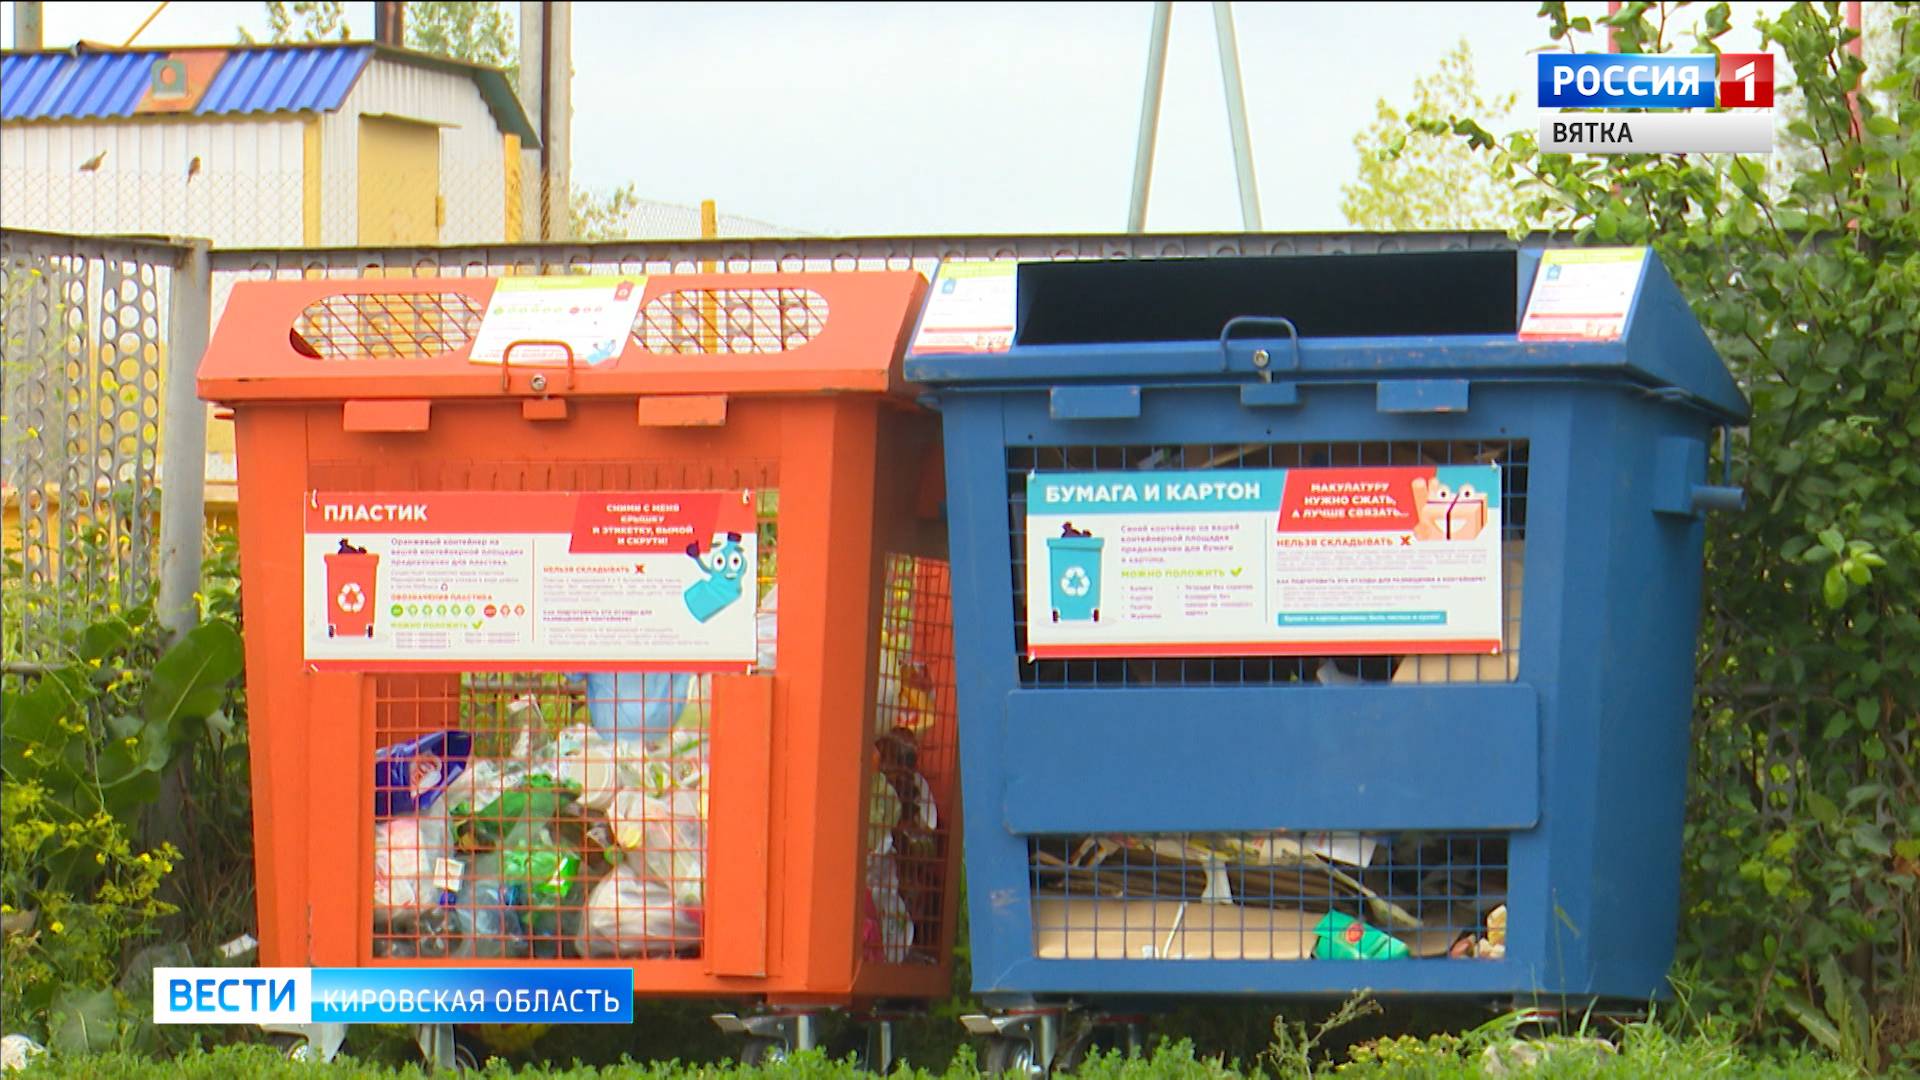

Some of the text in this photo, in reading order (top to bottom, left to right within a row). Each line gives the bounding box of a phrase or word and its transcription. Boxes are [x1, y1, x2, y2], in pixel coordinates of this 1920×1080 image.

[1046, 482, 1260, 502] БУМАГА И КАРТОН
[1311, 483, 1390, 493] МАКУЛАТУРУ
[1304, 495, 1397, 506] НУЖНО СЖАТЬ,
[324, 504, 429, 521] ПЛАСТИК
[607, 504, 680, 512] СНИМИ С МЕНЯ
[1292, 508, 1409, 518] А ЛУЧШЕ СВЯЗАТЬ...
[620, 515, 665, 523] КРЫШКУ
[592, 525, 694, 536] И ЭТИКЕТКУ, ВЫМОЙ
[1150, 524, 1196, 532] контейнер
[391, 538, 442, 547] Оранжевый
[443, 539, 488, 547] контейнер
[617, 537, 668, 545] И СКРУТИ!
[1277, 537, 1393, 548] НЕЛЬЗЯ СКЛАДЫВАТЬ
[576, 566, 630, 574] СКЛАДЫВАТЬ
[1165, 569, 1226, 577] ПОЛОЖИТЬ
